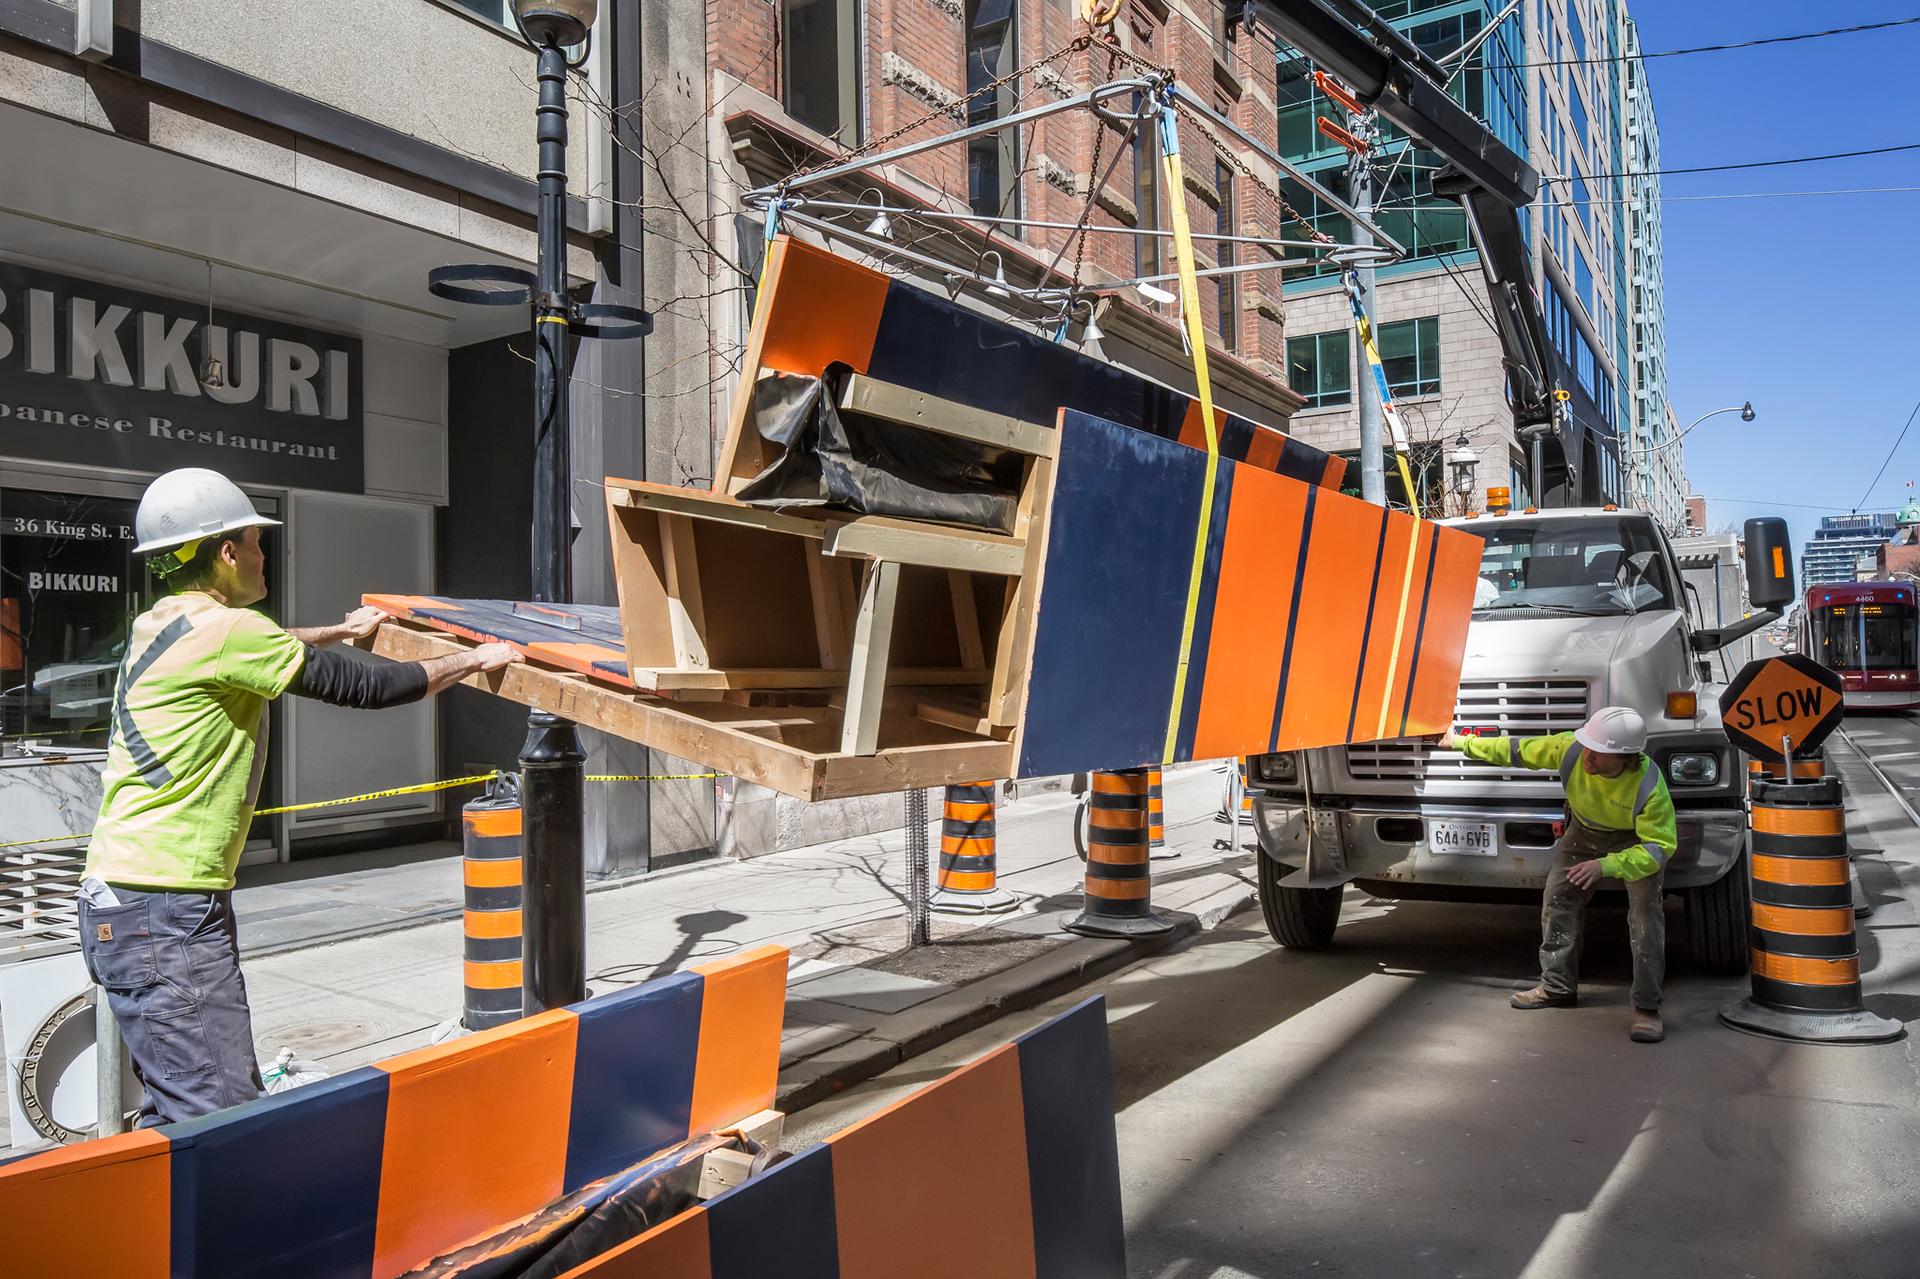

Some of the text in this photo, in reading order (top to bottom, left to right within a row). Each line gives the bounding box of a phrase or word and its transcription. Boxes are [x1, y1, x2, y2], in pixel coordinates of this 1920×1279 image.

[148, 416, 338, 460] Restaurant
[14, 518, 135, 540] 36 King St. E.
[29, 572, 118, 592] BIKKURI
[1736, 686, 1822, 730] SLOW
